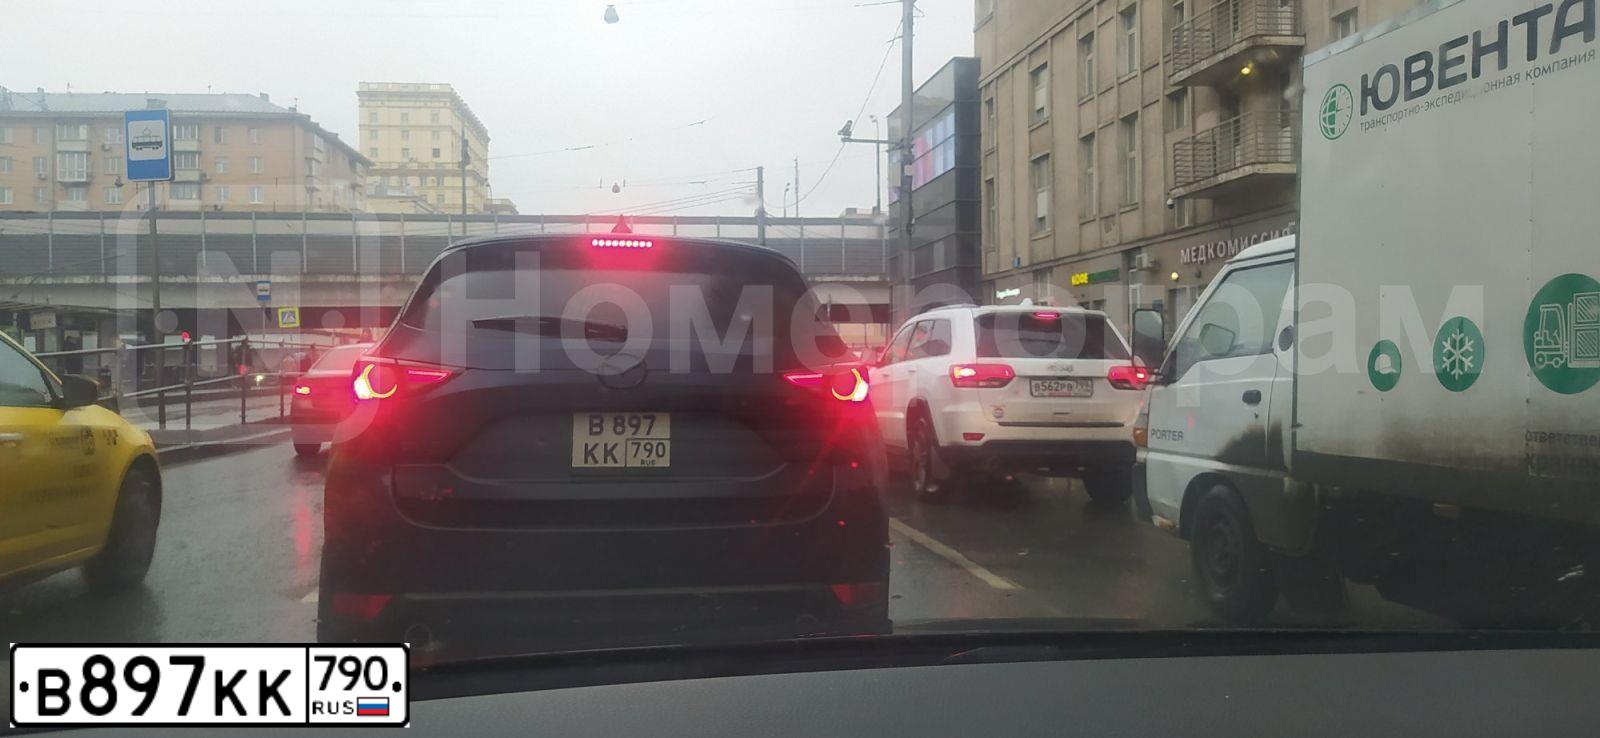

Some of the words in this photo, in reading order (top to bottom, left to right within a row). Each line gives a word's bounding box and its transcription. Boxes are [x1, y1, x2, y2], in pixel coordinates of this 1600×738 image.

[1360, 0, 1596, 116] ЮВЕНТА
[1360, 74, 1520, 132] транспортно-экспедонная
[1525, 49, 1596, 82] компания
[589, 414, 604, 436] В
[613, 414, 656, 436] 897
[1151, 429, 1184, 441] PORTER
[583, 442, 619, 464] КК
[631, 442, 666, 458] 790
